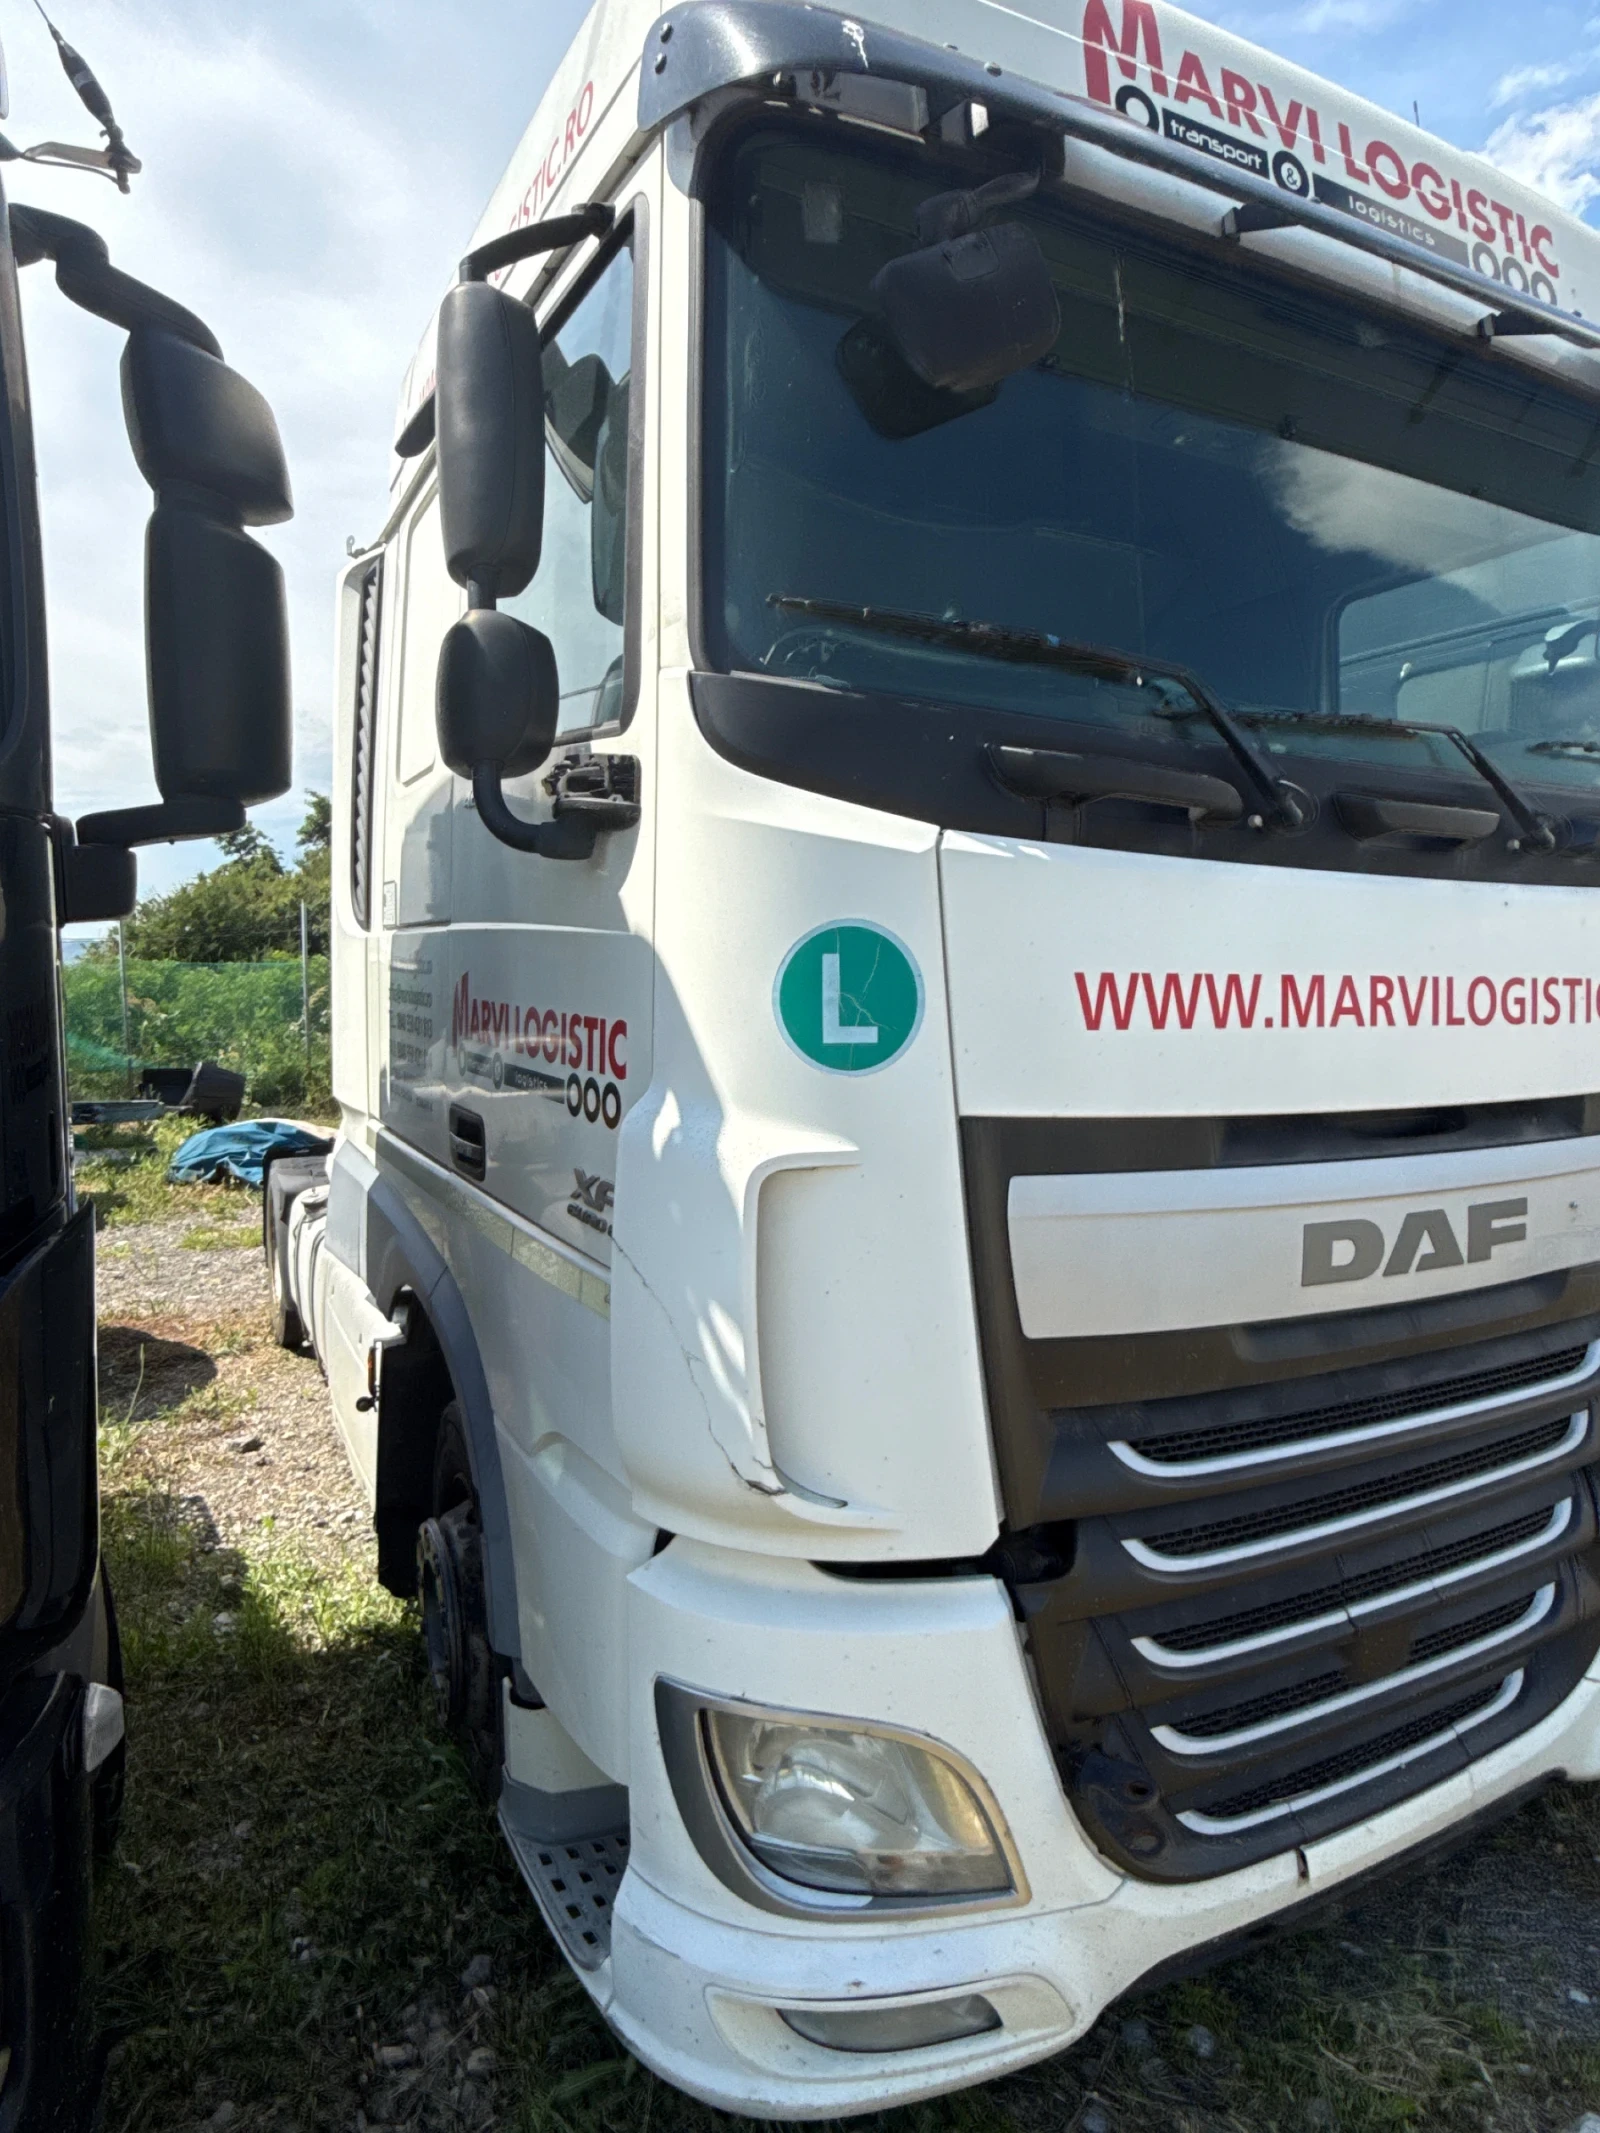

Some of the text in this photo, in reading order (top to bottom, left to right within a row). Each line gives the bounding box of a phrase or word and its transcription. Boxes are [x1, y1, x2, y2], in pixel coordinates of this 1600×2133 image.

[1170, 119, 1436, 247] transport & logistics
[1338, 122, 1560, 279] LOGISTIC
[822, 953, 878, 1044] L
[1074, 972, 1600, 1031] WWW.MARVILOGISTI
[1301, 1197, 1528, 1287] DAF
